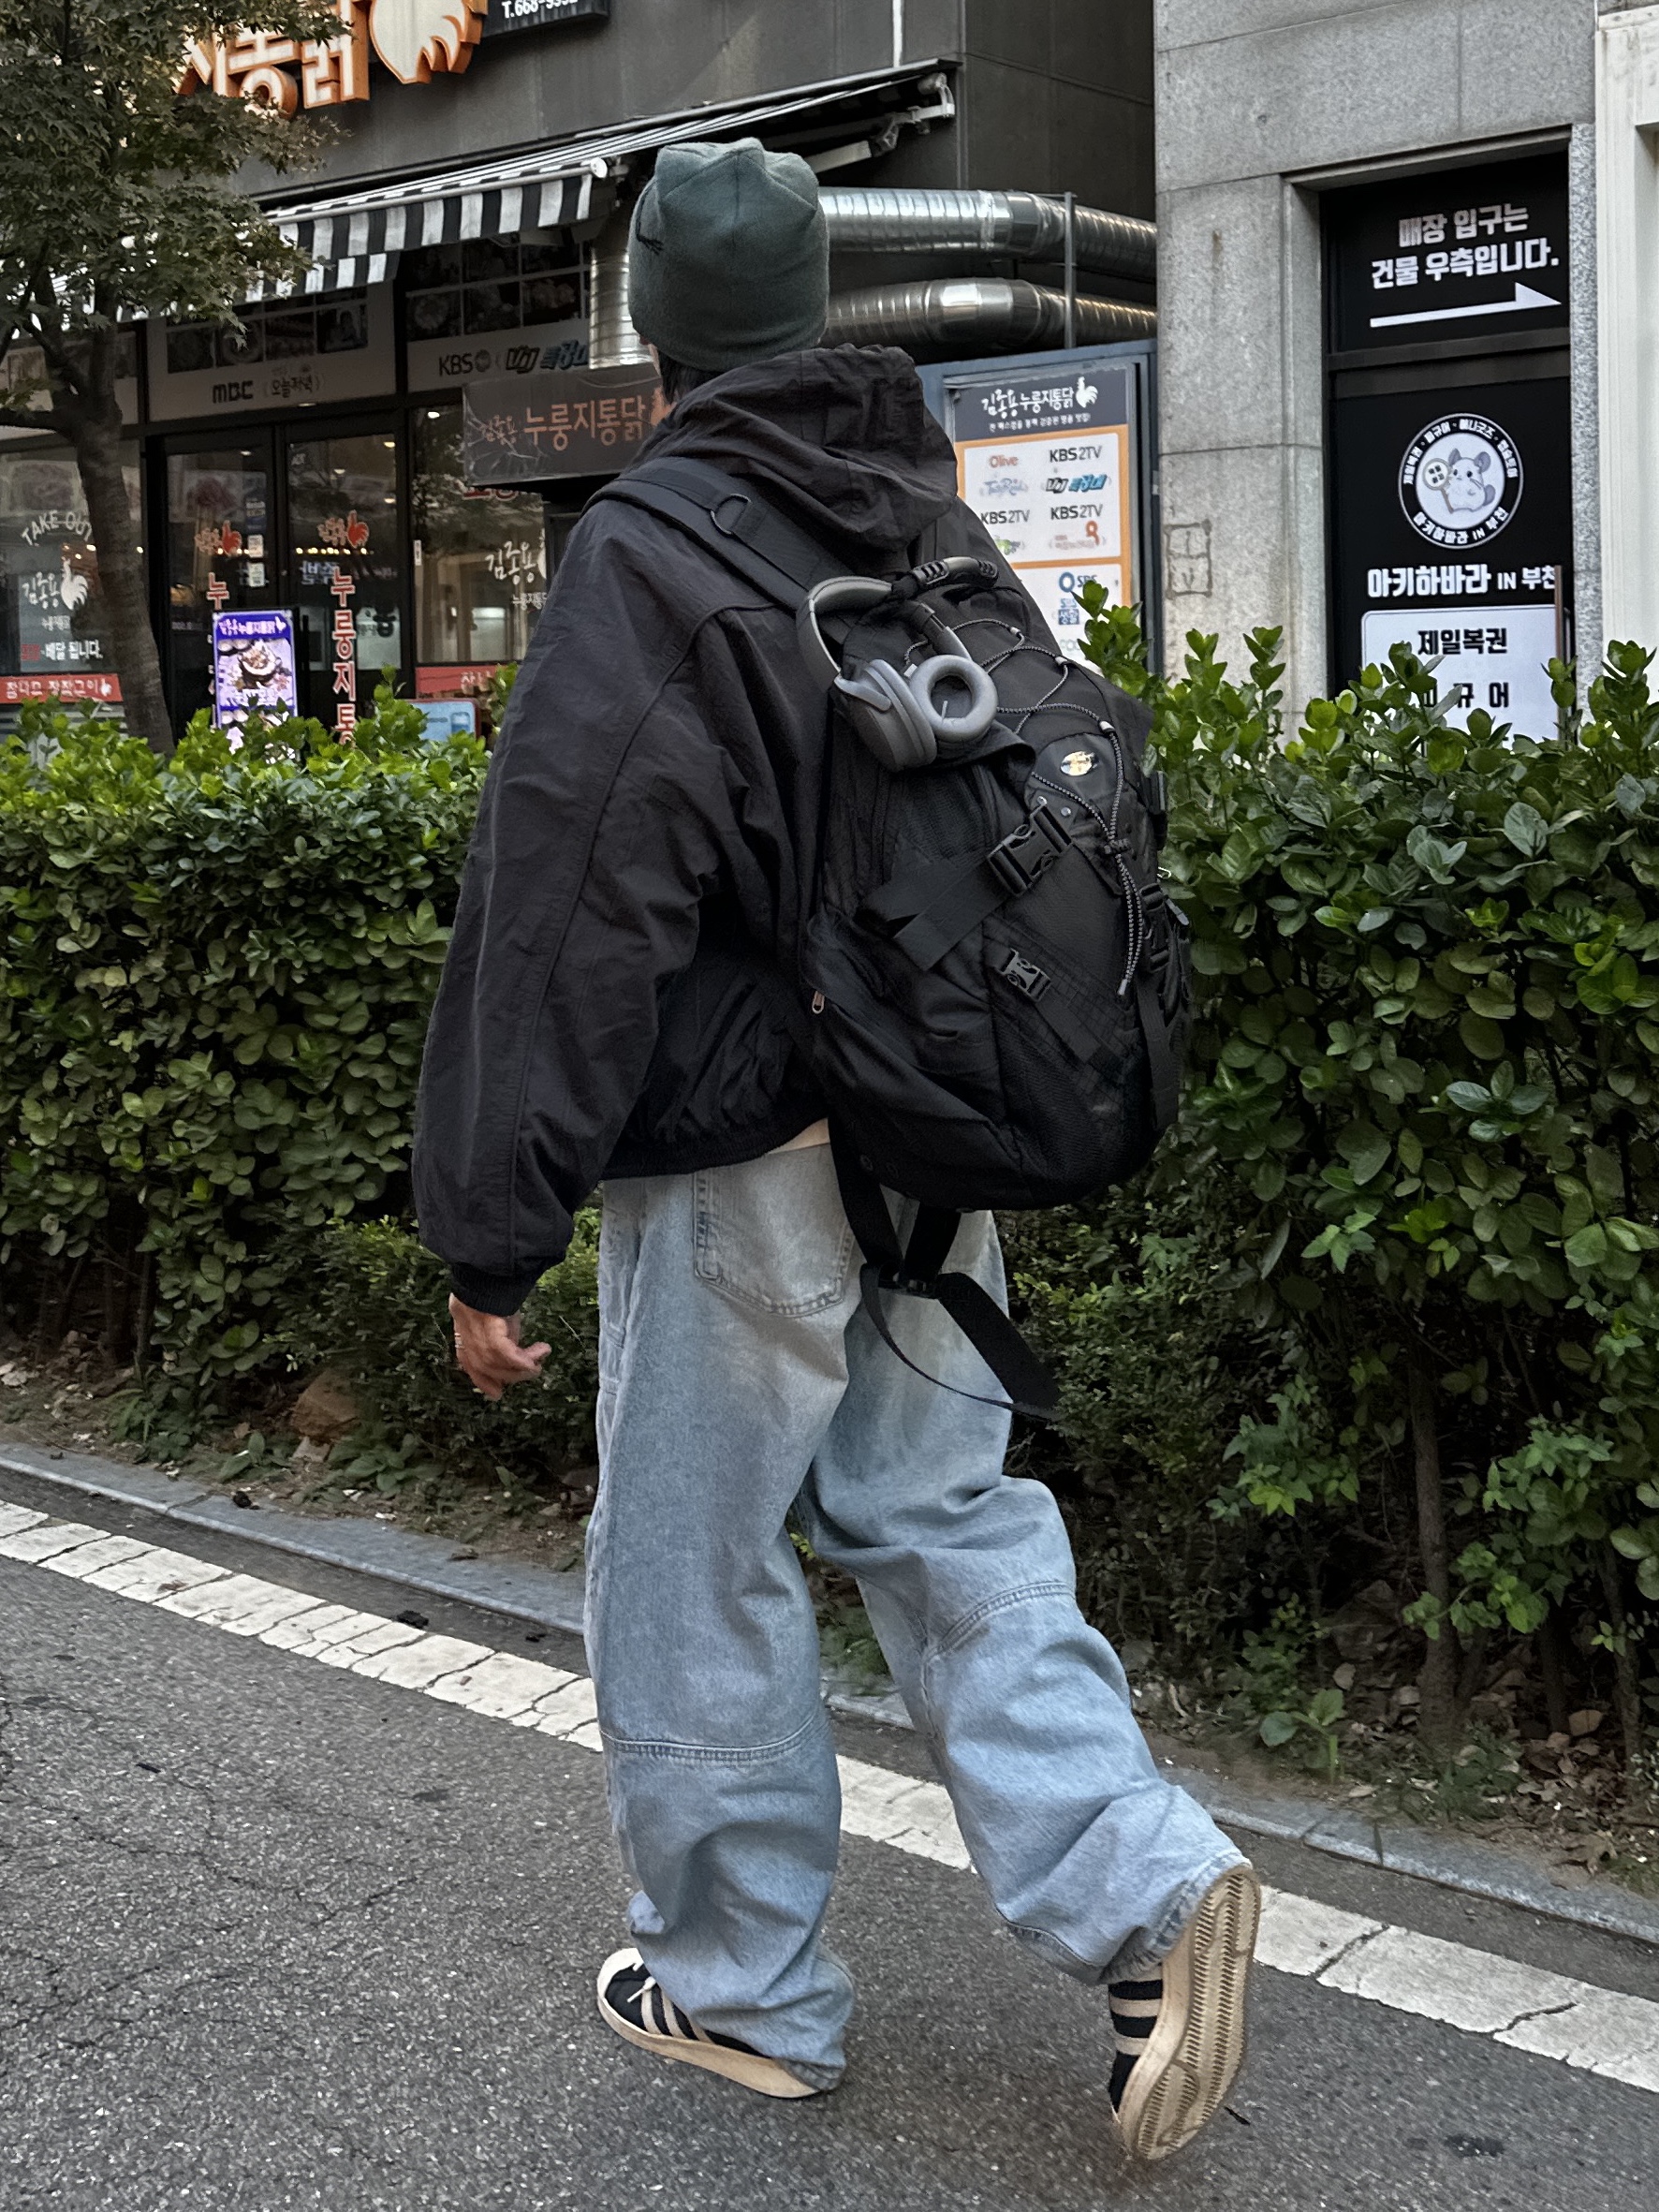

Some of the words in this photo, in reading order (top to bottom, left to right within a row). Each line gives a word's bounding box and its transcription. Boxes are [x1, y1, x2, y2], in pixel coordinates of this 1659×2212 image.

[1399, 214, 1447, 247] 매장
[1453, 203, 1529, 240] 입구는
[1372, 255, 1418, 289] 건물
[1425, 237, 1560, 282] 우측입니다.
[439, 352, 472, 376] KBS
[981, 389, 1019, 420] 김종용
[1019, 387, 1075, 414] 누룽지통닭
[522, 394, 646, 451] 누룽지통닭
[989, 454, 1020, 468] Olive
[21, 509, 59, 546] TAKE
[66, 509, 93, 542] OUT
[485, 540, 537, 584] 김종용
[1367, 564, 1491, 598] 아키하바라
[1497, 571, 1517, 590] IN
[1417, 627, 1507, 655] 제일복권
